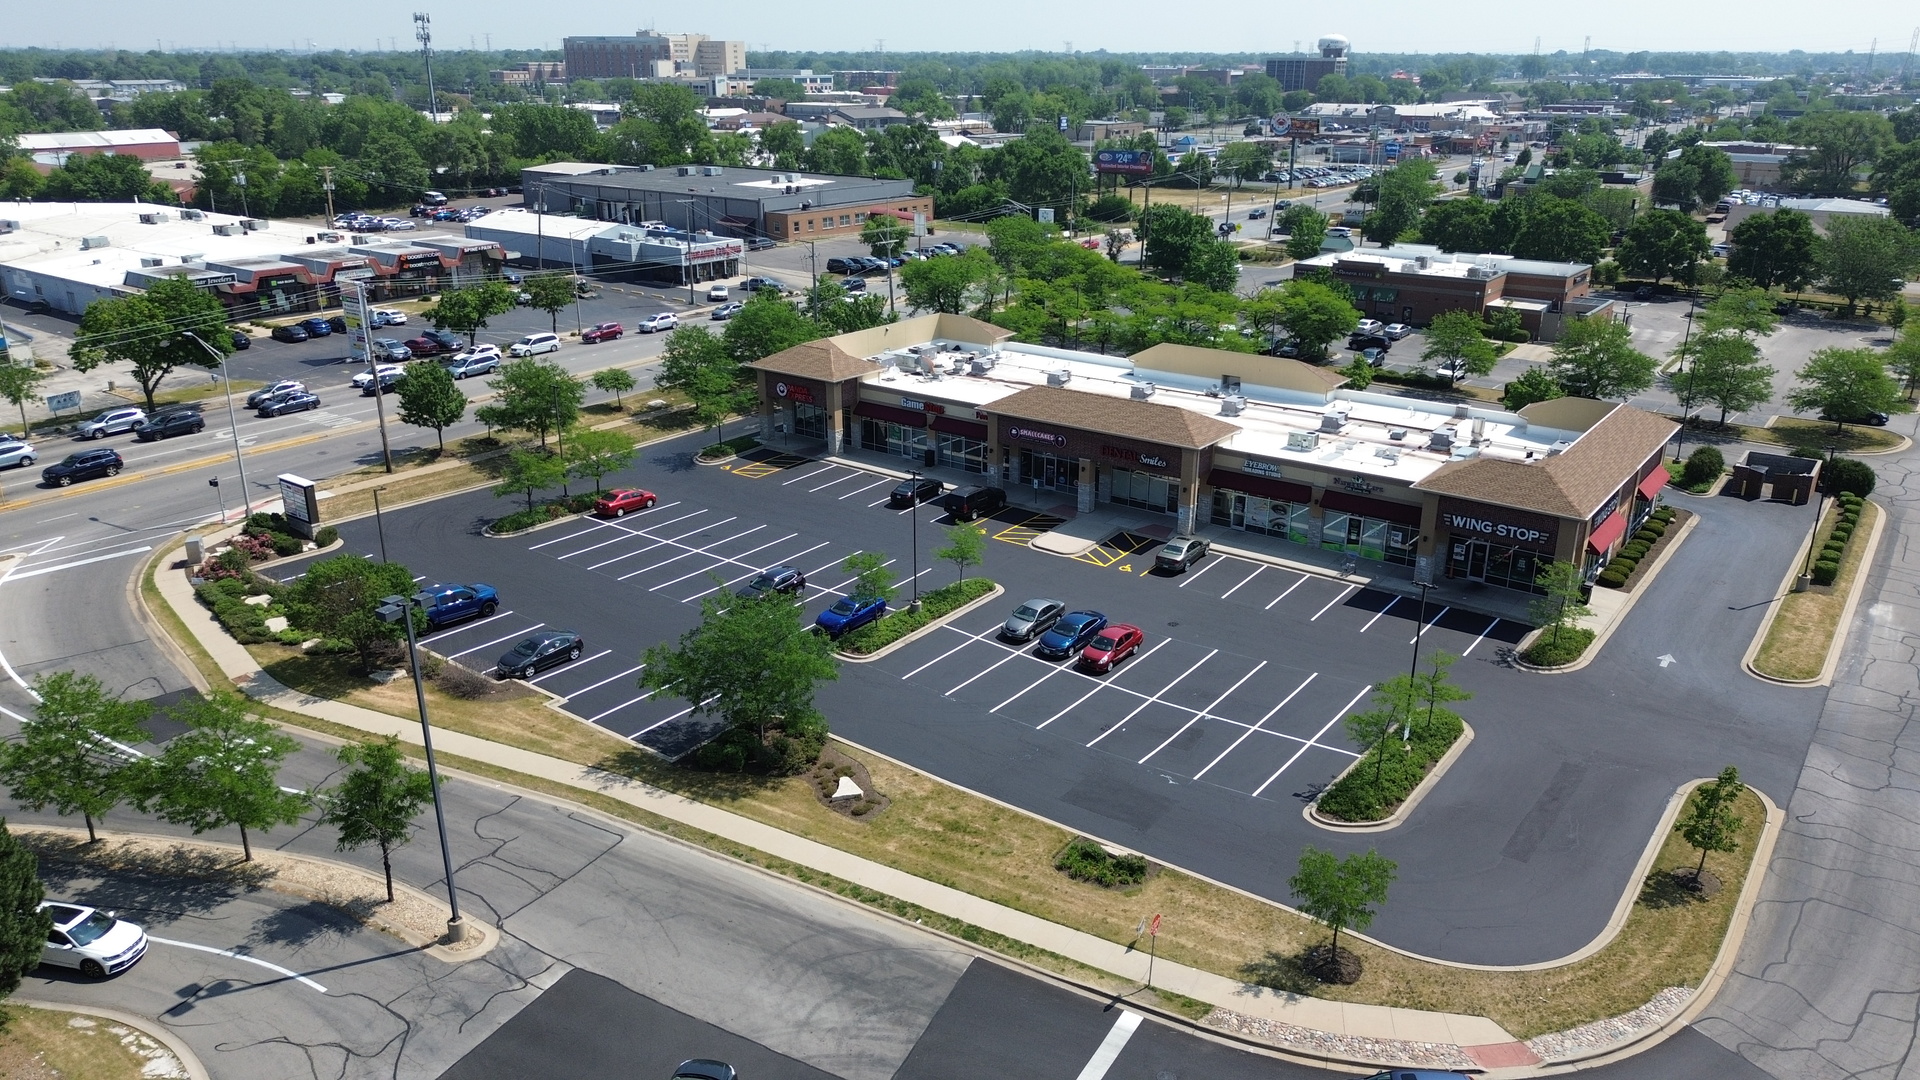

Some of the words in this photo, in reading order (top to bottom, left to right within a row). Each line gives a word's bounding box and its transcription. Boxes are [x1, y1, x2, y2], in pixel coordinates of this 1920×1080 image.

[786, 384, 808, 395] PANDA
[788, 392, 814, 403] EXPRESS
[1020, 429, 1056, 441] SMALLCAKES
[1101, 445, 1138, 461] DENTAL
[1139, 453, 1167, 467] Smiles
[1244, 460, 1280, 471] EYEBROW
